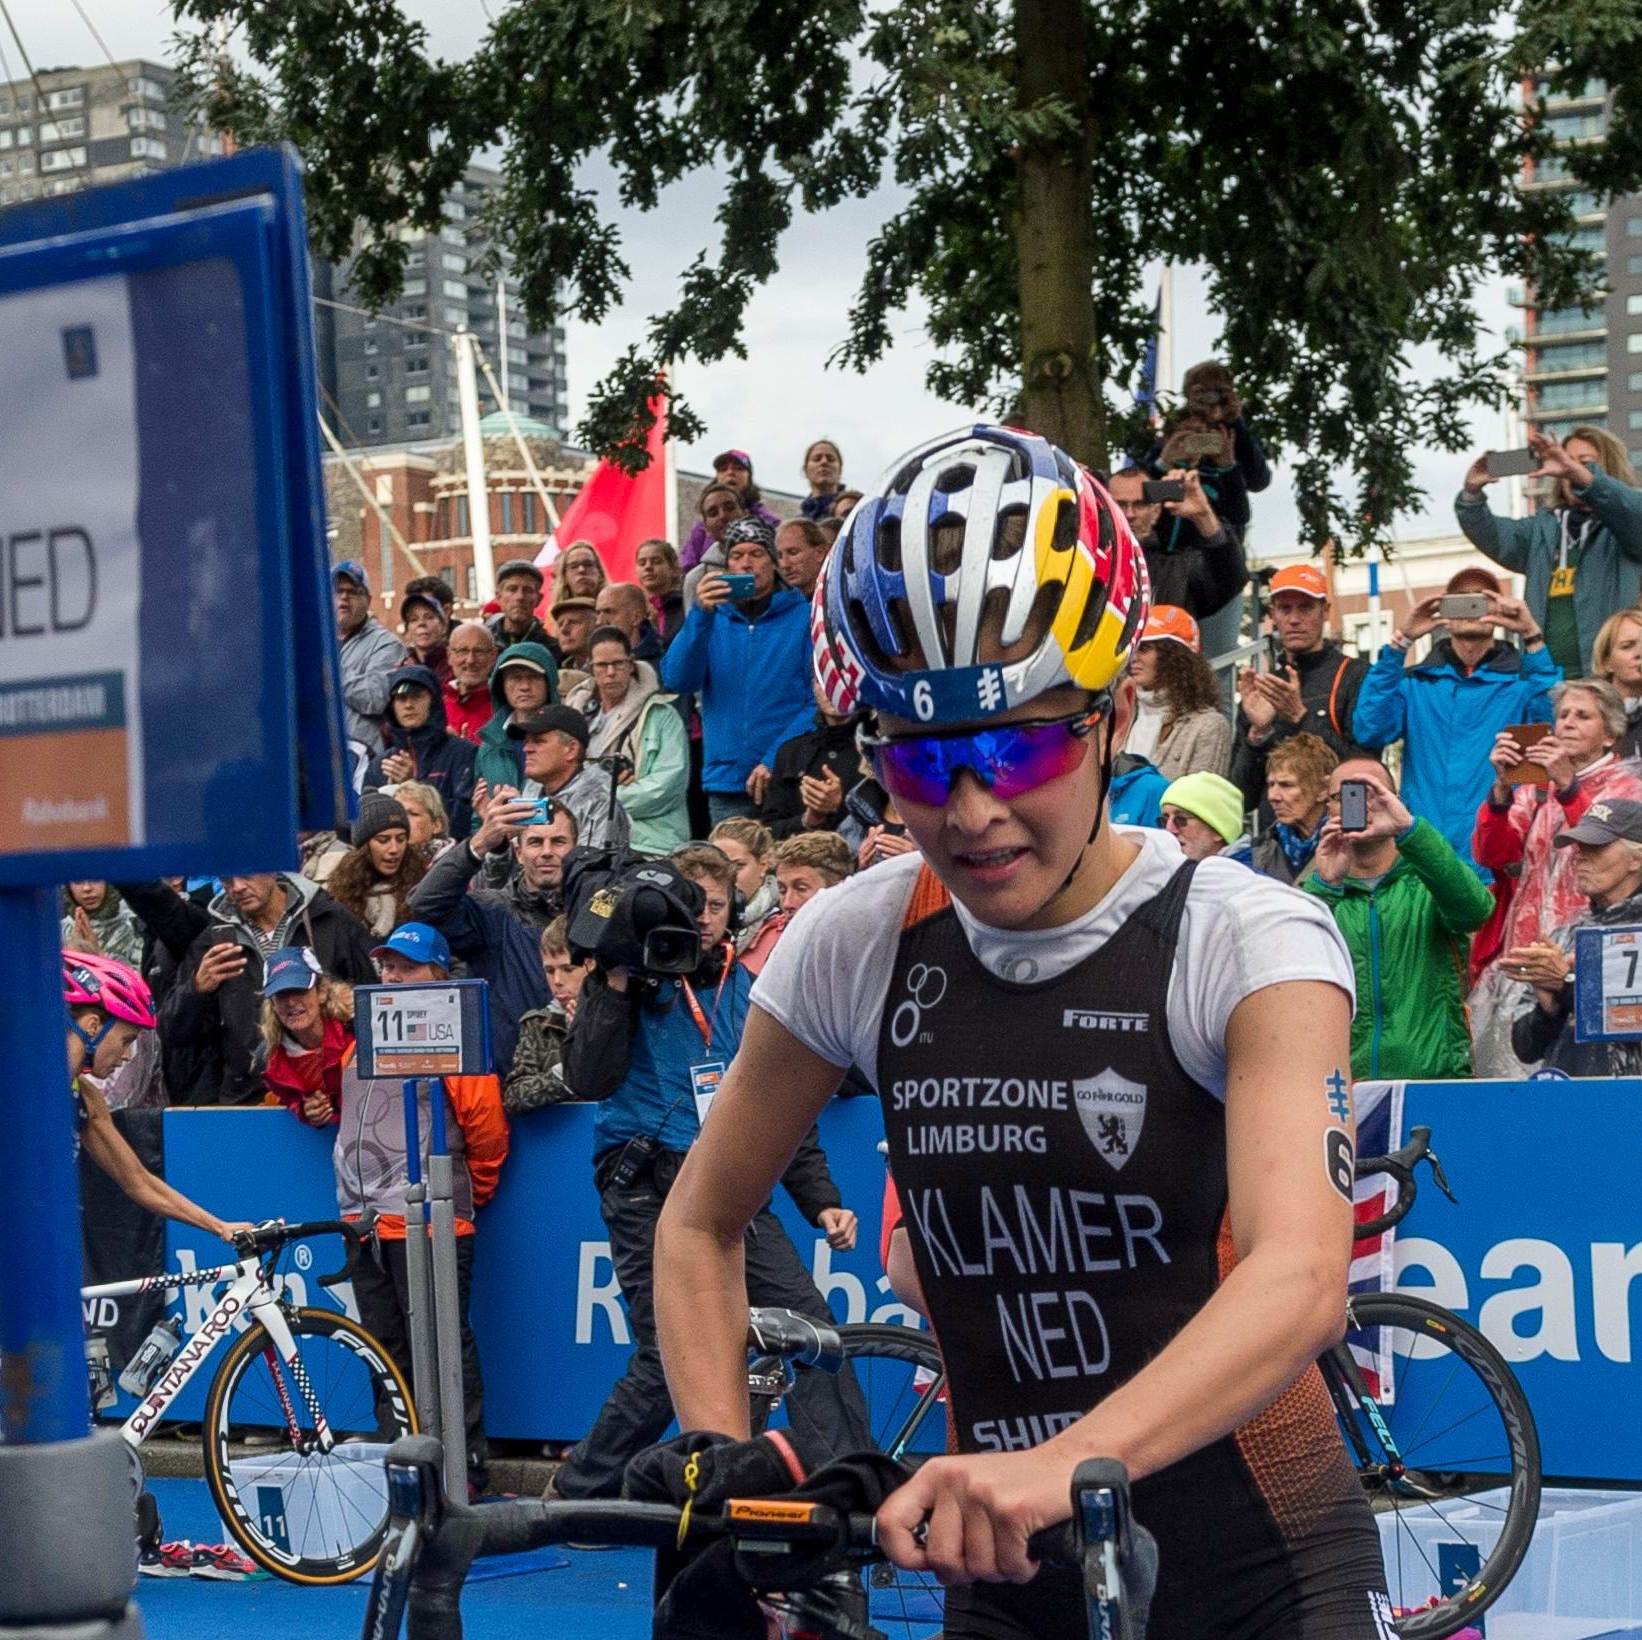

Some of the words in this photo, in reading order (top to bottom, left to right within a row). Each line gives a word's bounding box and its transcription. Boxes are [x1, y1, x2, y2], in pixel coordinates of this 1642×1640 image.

[913, 680, 934, 722] 6
[1622, 949, 1639, 989] 7
[377, 1010, 403, 1042] 11
[429, 1023, 455, 1041] USA
[1063, 1009, 1150, 1032] FORTE
[919, 1032, 934, 1044] ITU
[892, 1076, 1068, 1112] SPORTZONE
[907, 1124, 1047, 1157] LIMBURG
[1323, 1130, 1353, 1204] 6
[908, 1184, 1172, 1278] KLAMER
[996, 1289, 1112, 1383] NED
[1361, 1395, 1401, 1459] FELT
[262, 1515, 286, 1539] 11
[735, 1505, 808, 1519] Pioneer
